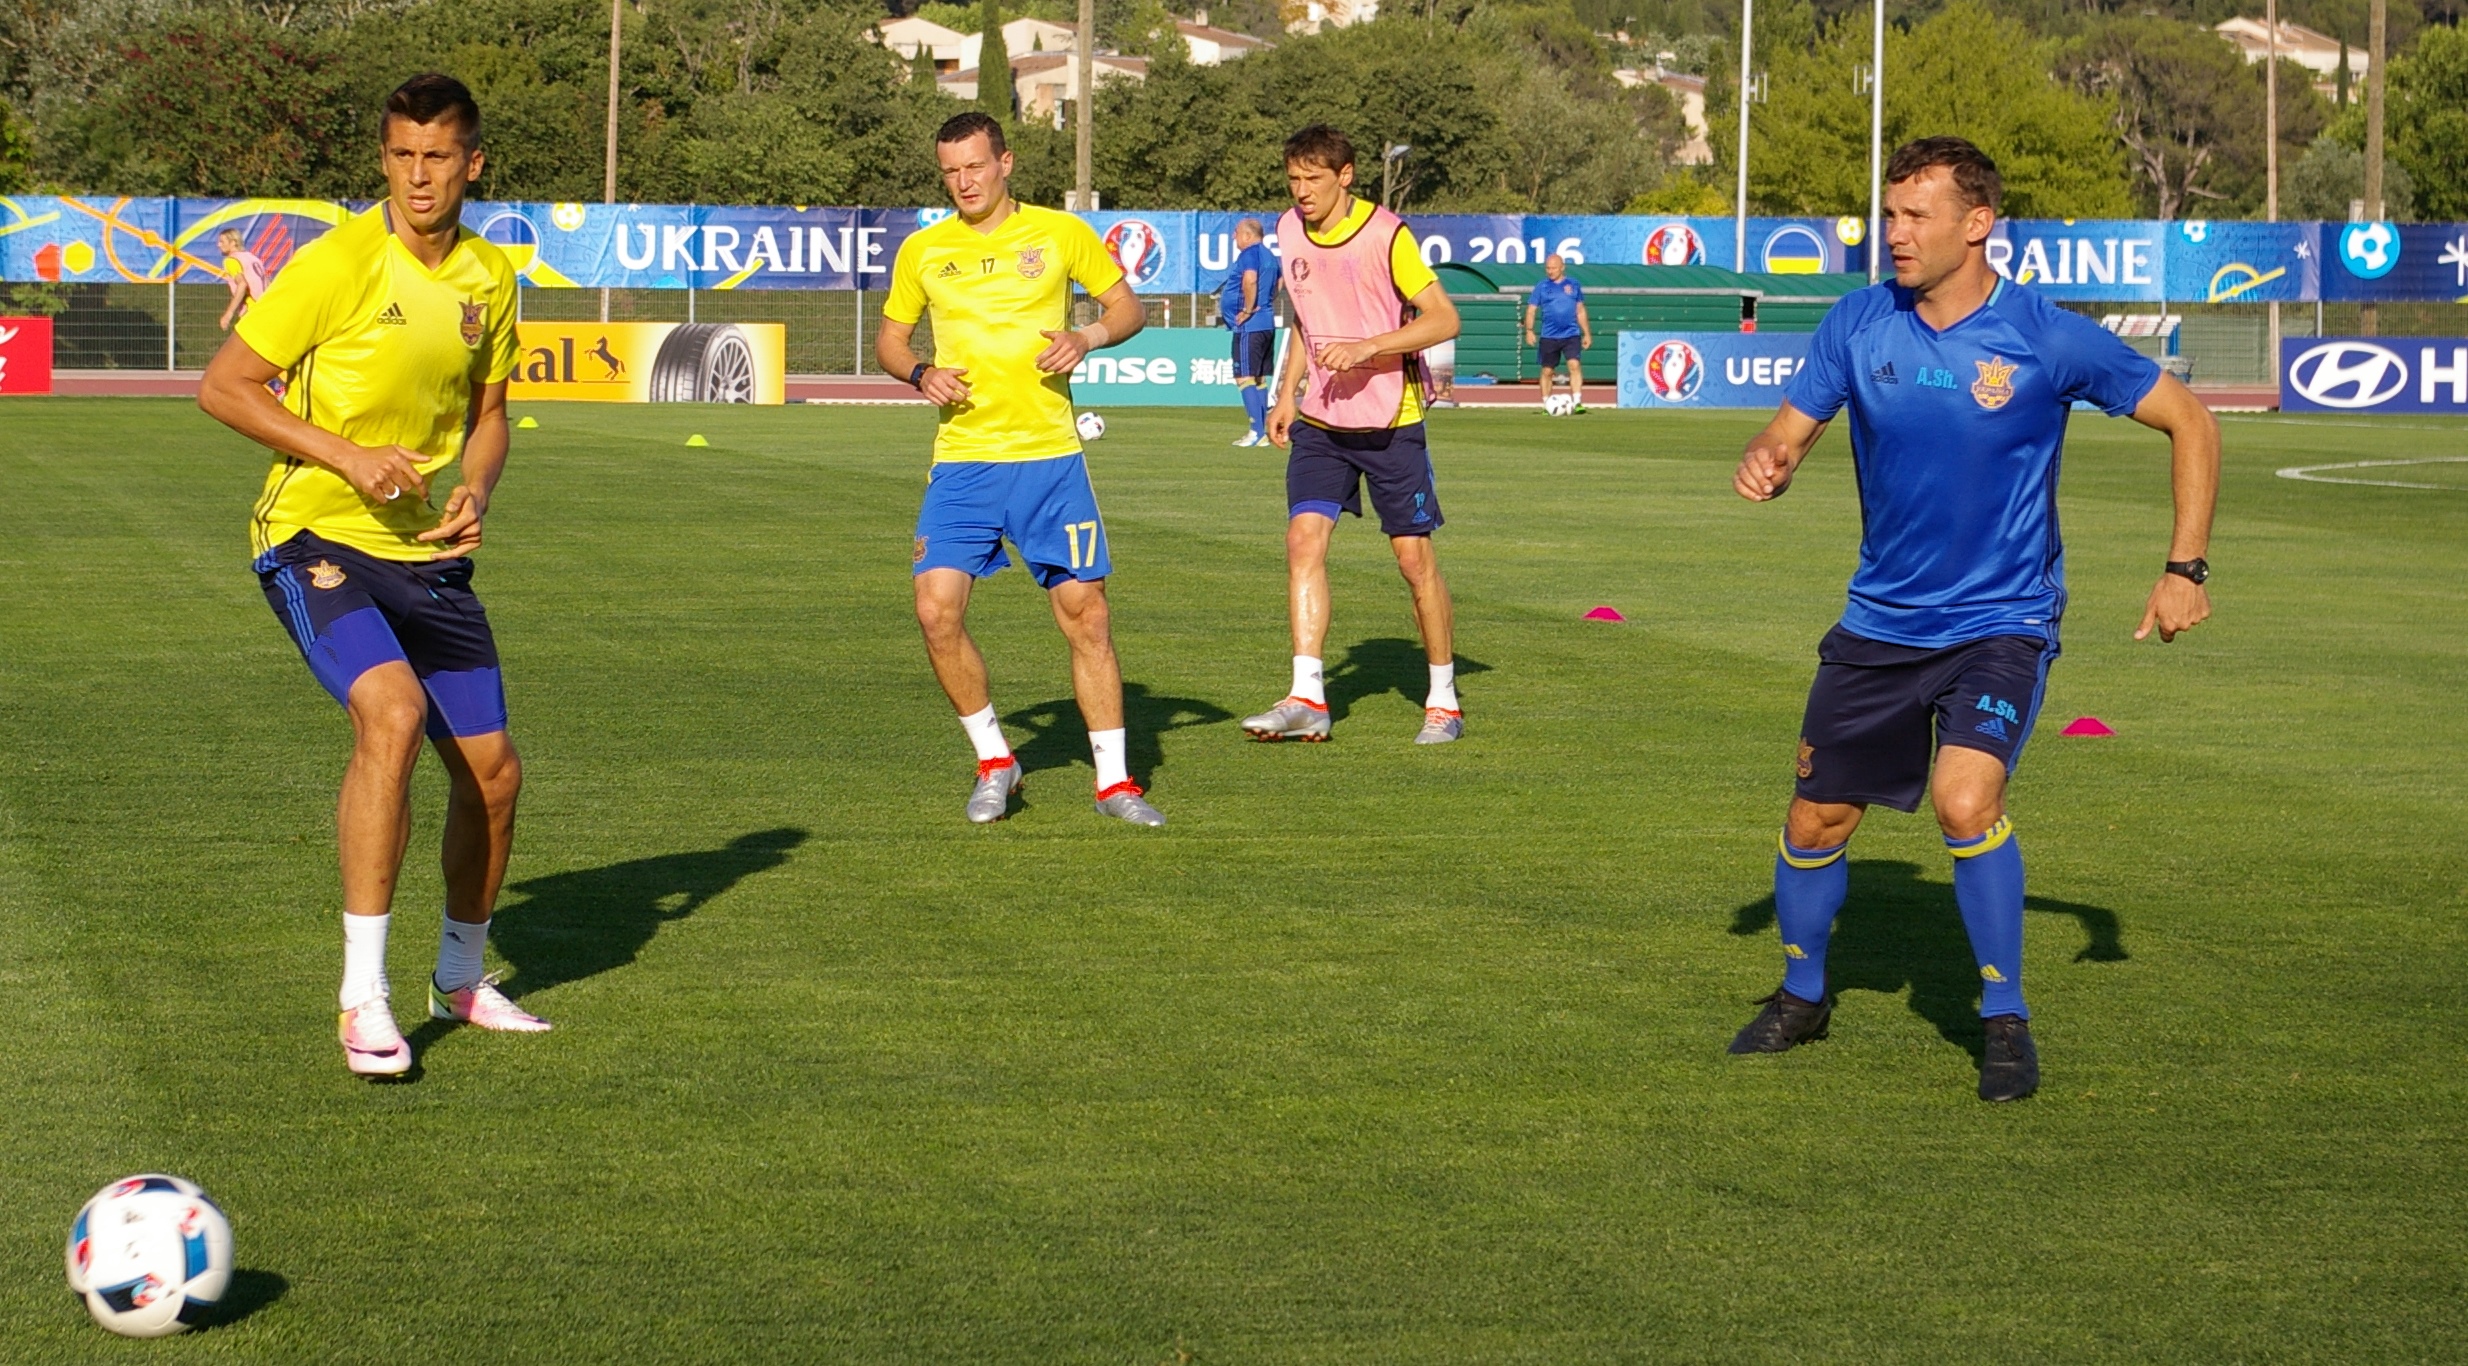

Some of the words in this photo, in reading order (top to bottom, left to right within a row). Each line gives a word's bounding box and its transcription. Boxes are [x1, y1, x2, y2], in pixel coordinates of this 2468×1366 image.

[616, 223, 887, 272] UKRAINE
[1469, 237, 1584, 265] 2016
[1985, 239, 2151, 284] RAINE
[981, 258, 995, 274] 17
[1916, 366, 1958, 390] A.Sh.
[1064, 520, 1098, 569] 17
[1976, 695, 2019, 725] A.Sh.
